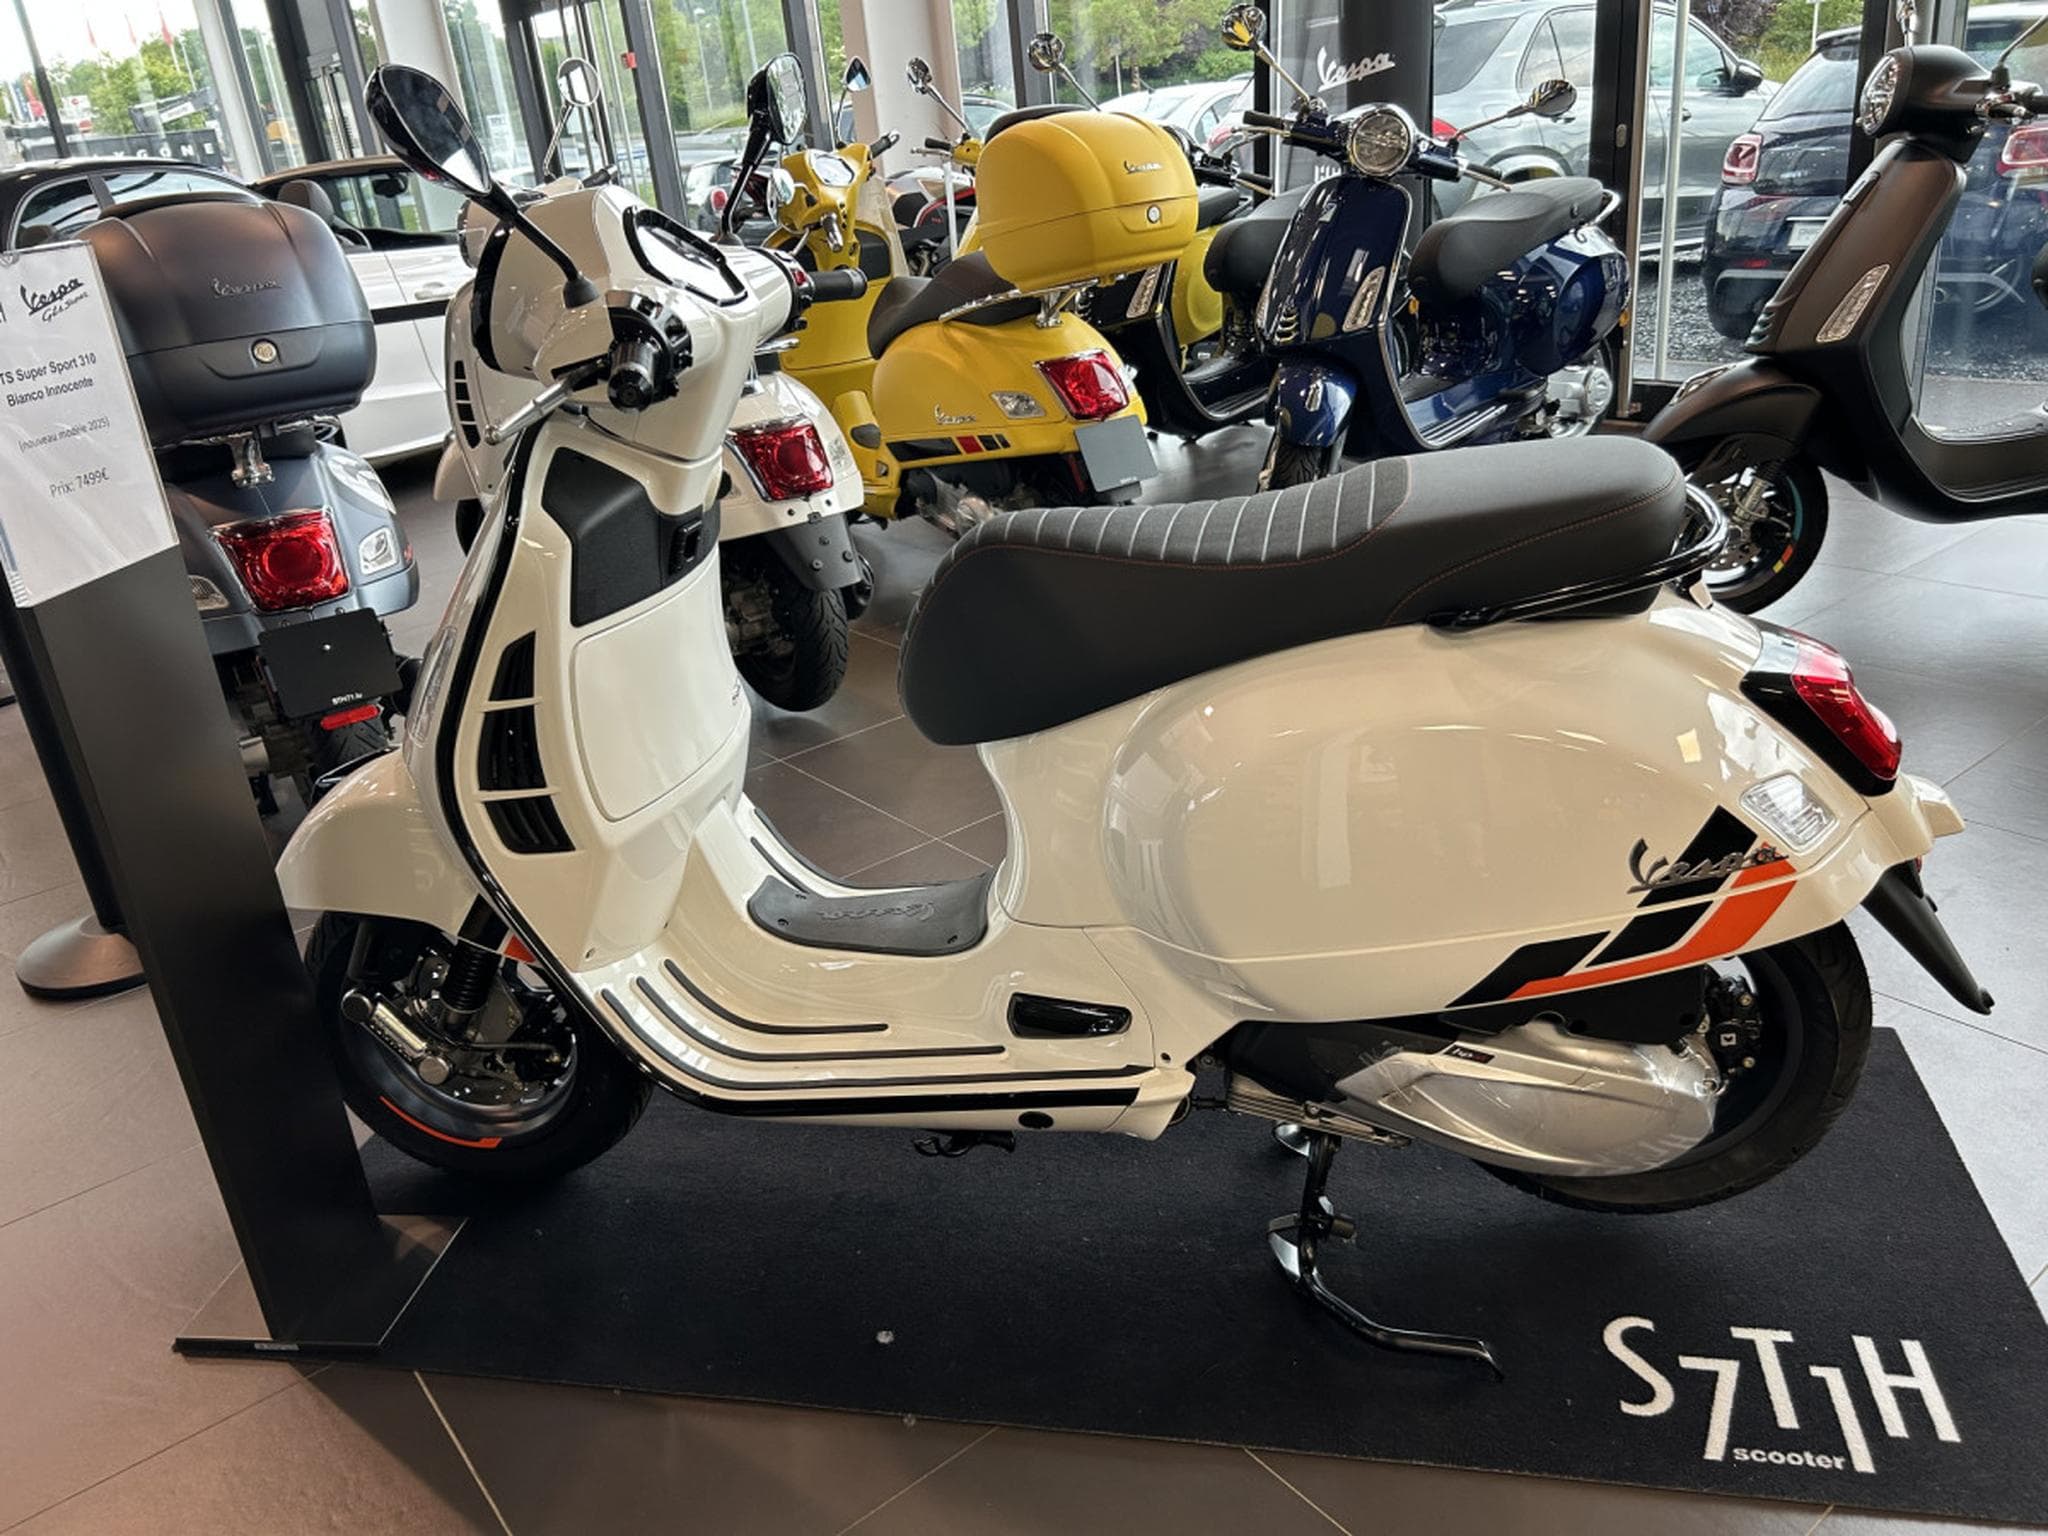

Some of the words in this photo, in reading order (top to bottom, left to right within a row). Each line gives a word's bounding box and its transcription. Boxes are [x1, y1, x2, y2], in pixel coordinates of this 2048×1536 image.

[1317, 45, 1395, 92] Vespa
[20, 278, 84, 316] Vespa
[15, 366, 47, 382] Super
[48, 358, 78, 374] Sport
[78, 352, 97, 366] 310
[6, 389, 44, 407] Bianco
[45, 377, 94, 397] Innocente
[76, 467, 110, 488] 7499€
[1627, 838, 1789, 893] Vespa
[1733, 1446, 1846, 1471] scooter
